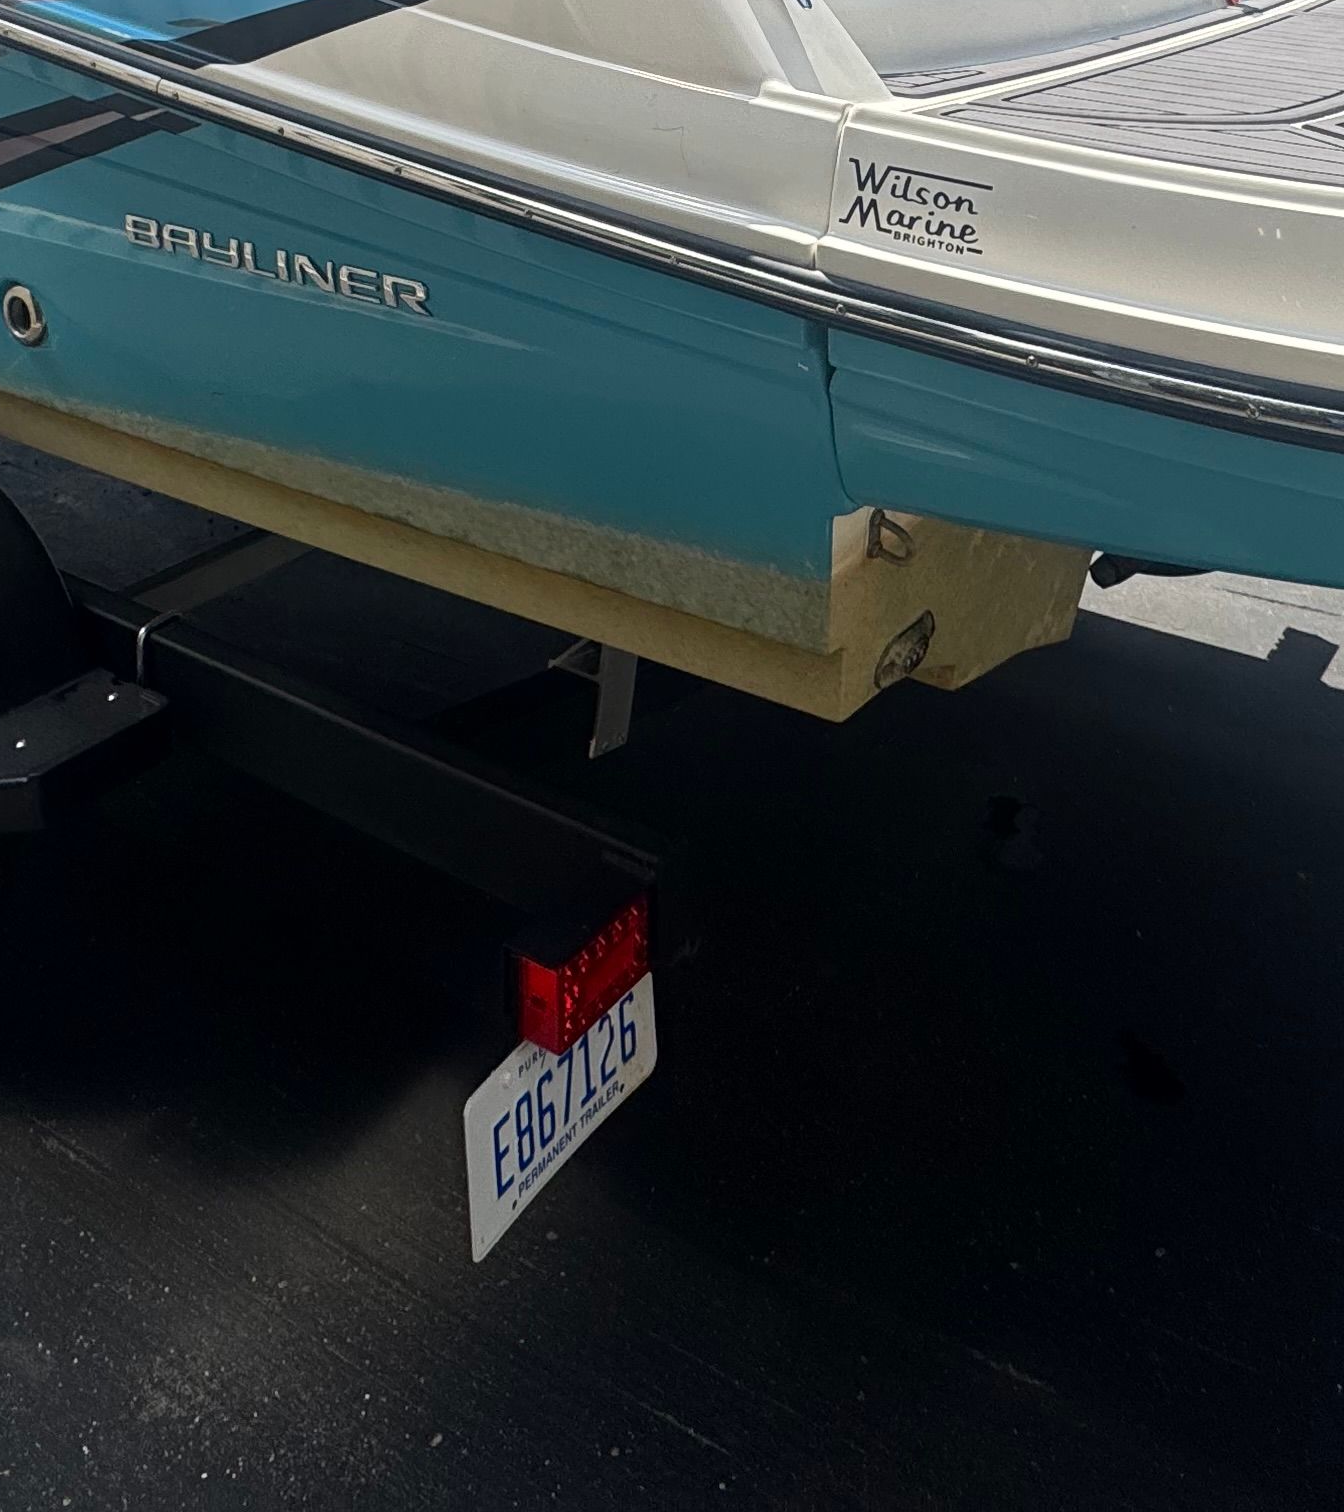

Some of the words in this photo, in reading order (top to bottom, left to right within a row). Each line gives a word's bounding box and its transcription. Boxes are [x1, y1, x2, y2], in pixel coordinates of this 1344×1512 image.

[838, 195, 980, 244] Marine
[848, 157, 994, 215] Wilson
[124, 213, 434, 317] BAYLINER
[893, 230, 965, 255] BRIGHTON
[493, 991, 637, 1201] E867126
[517, 1121, 578, 1199] PERMANENT
[579, 1080, 621, 1130] TRAILER
